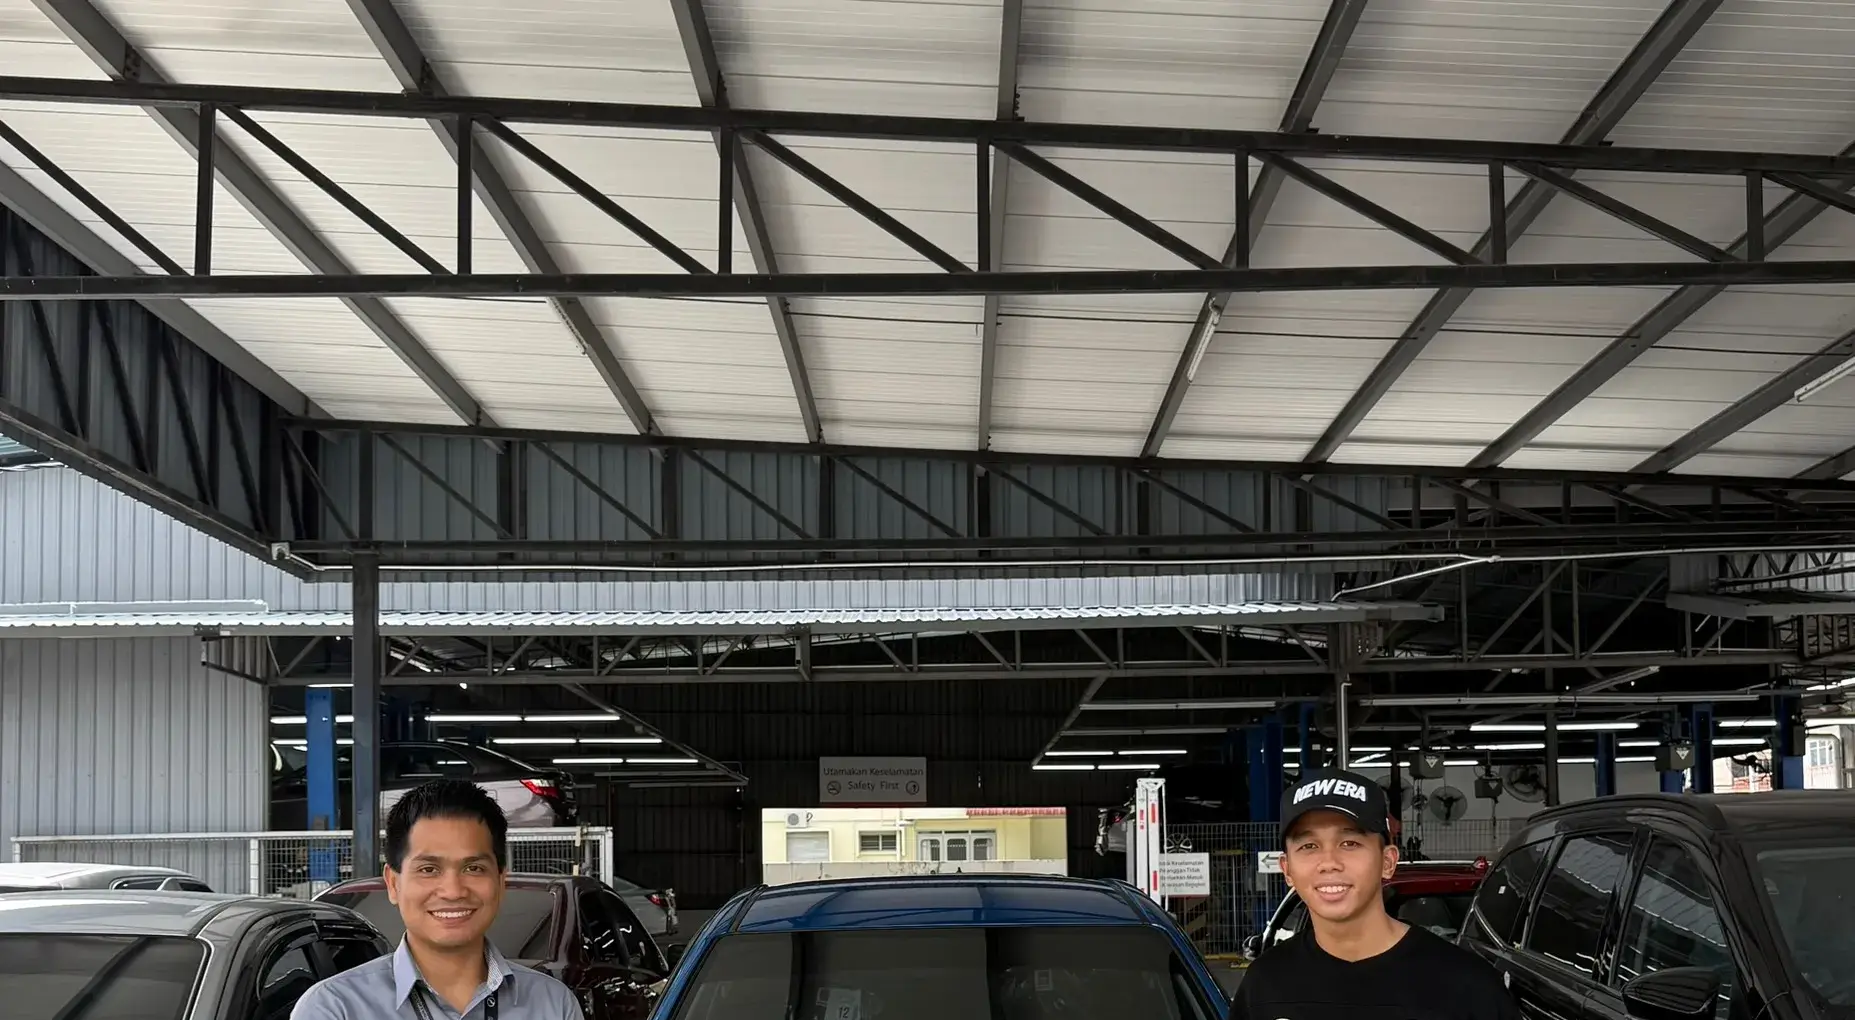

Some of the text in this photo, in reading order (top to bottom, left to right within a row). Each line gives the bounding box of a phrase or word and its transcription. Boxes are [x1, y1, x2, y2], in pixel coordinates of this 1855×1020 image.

[823, 767, 924, 776] Utamakan Keselamatan
[847, 781, 900, 792] Safety First
[1293, 778, 1367, 805] NEW ERA
[839, 1006, 850, 1019] 12
